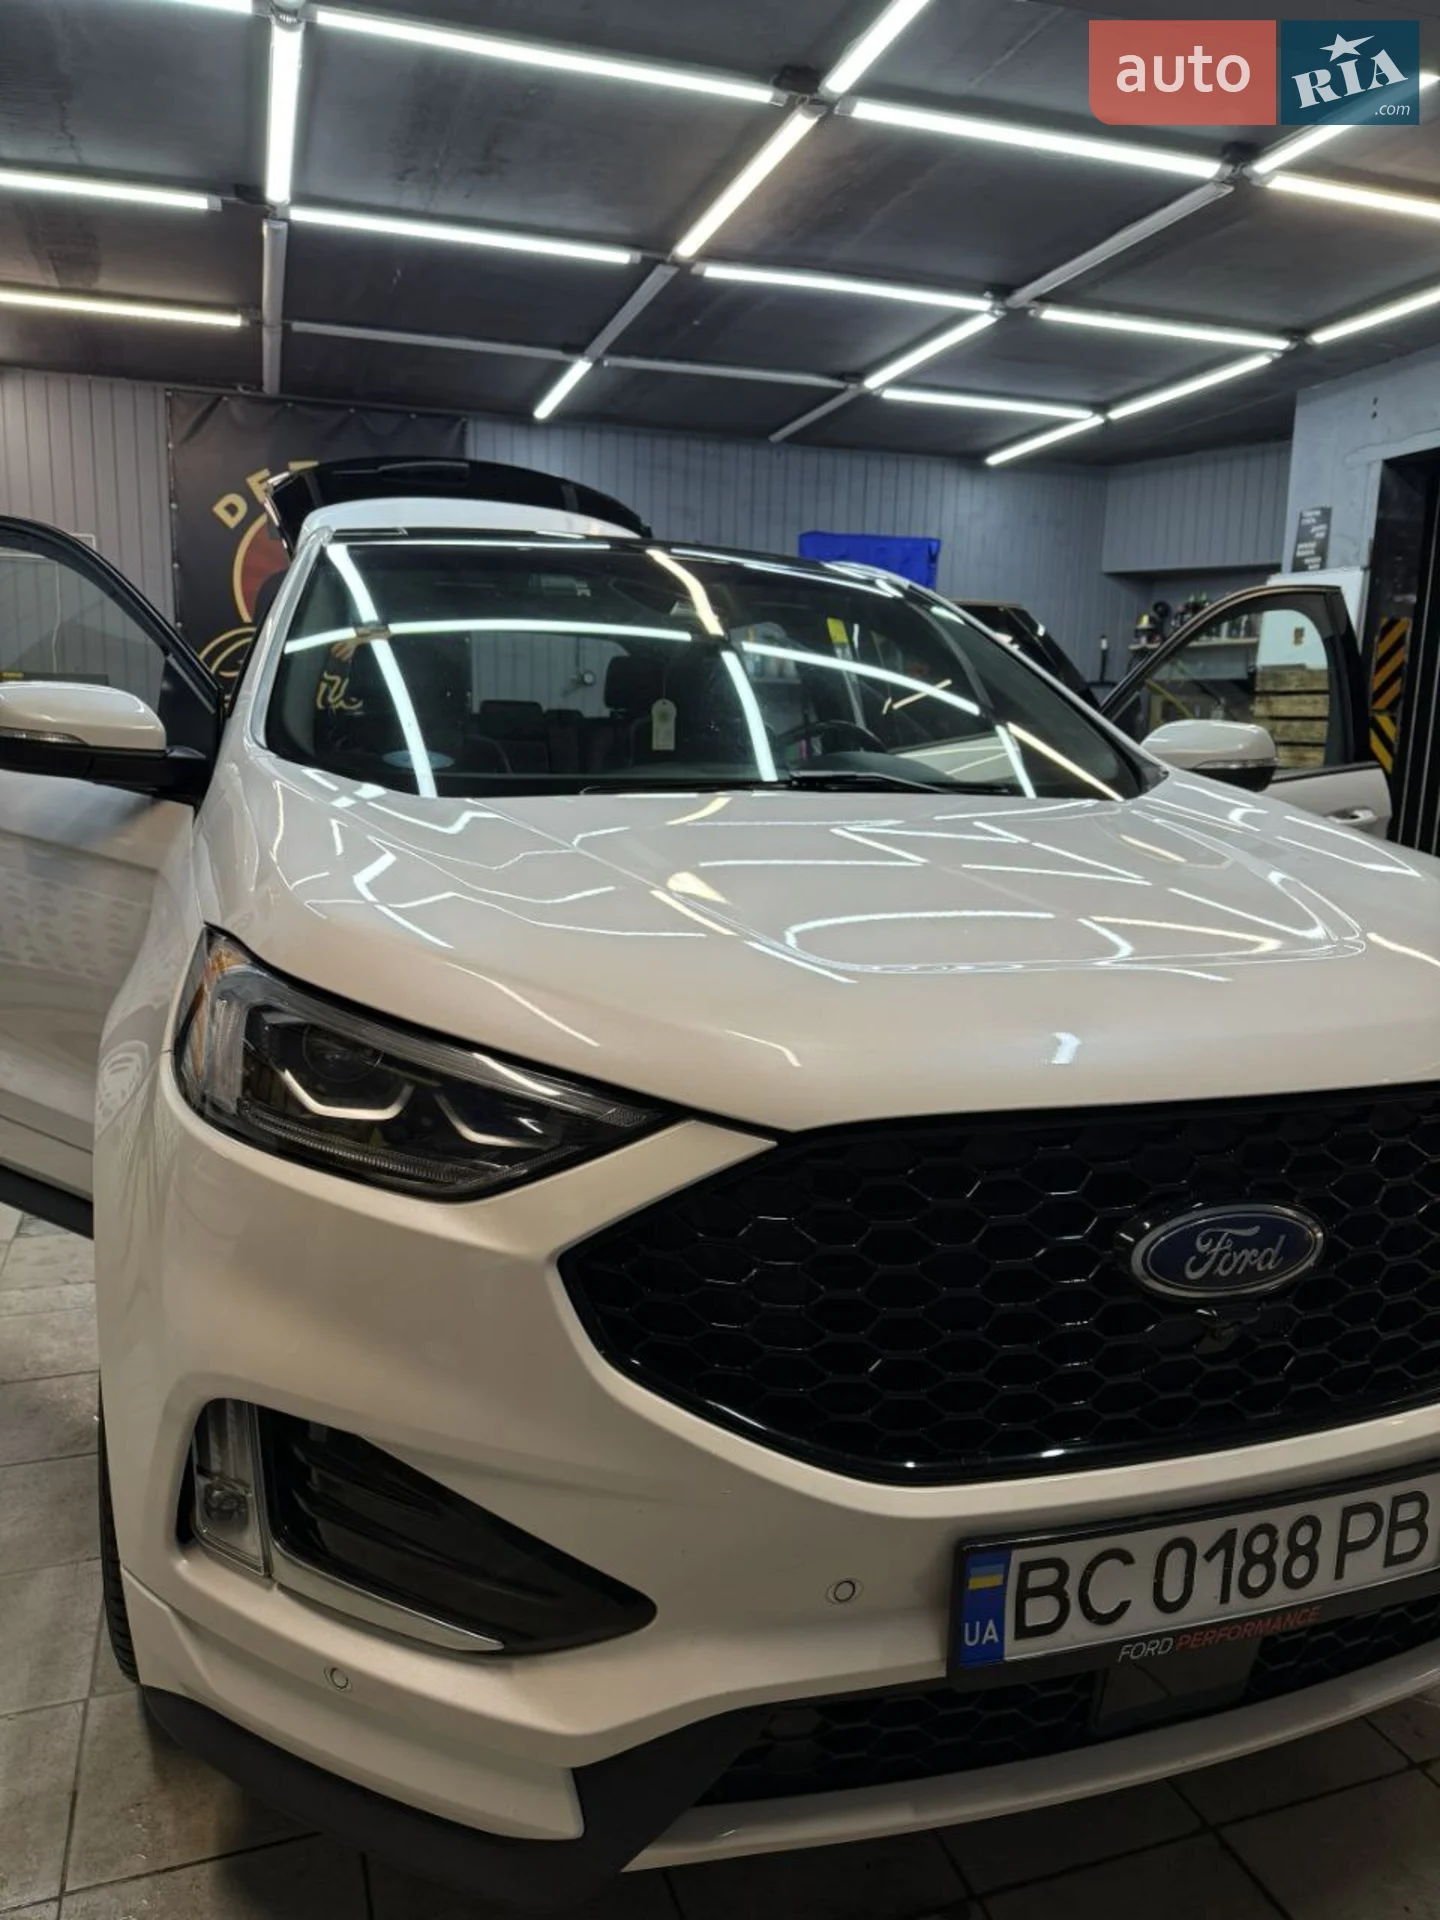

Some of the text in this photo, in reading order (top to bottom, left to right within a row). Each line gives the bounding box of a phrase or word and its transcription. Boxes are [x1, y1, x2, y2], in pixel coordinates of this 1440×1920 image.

[1185, 1225, 1286, 1280] Ford
[1013, 1490, 1430, 1641] BC 0188 PB
[964, 1619, 999, 1646] UA
[1117, 1606, 1322, 1663] FORD PERFORMANCE
